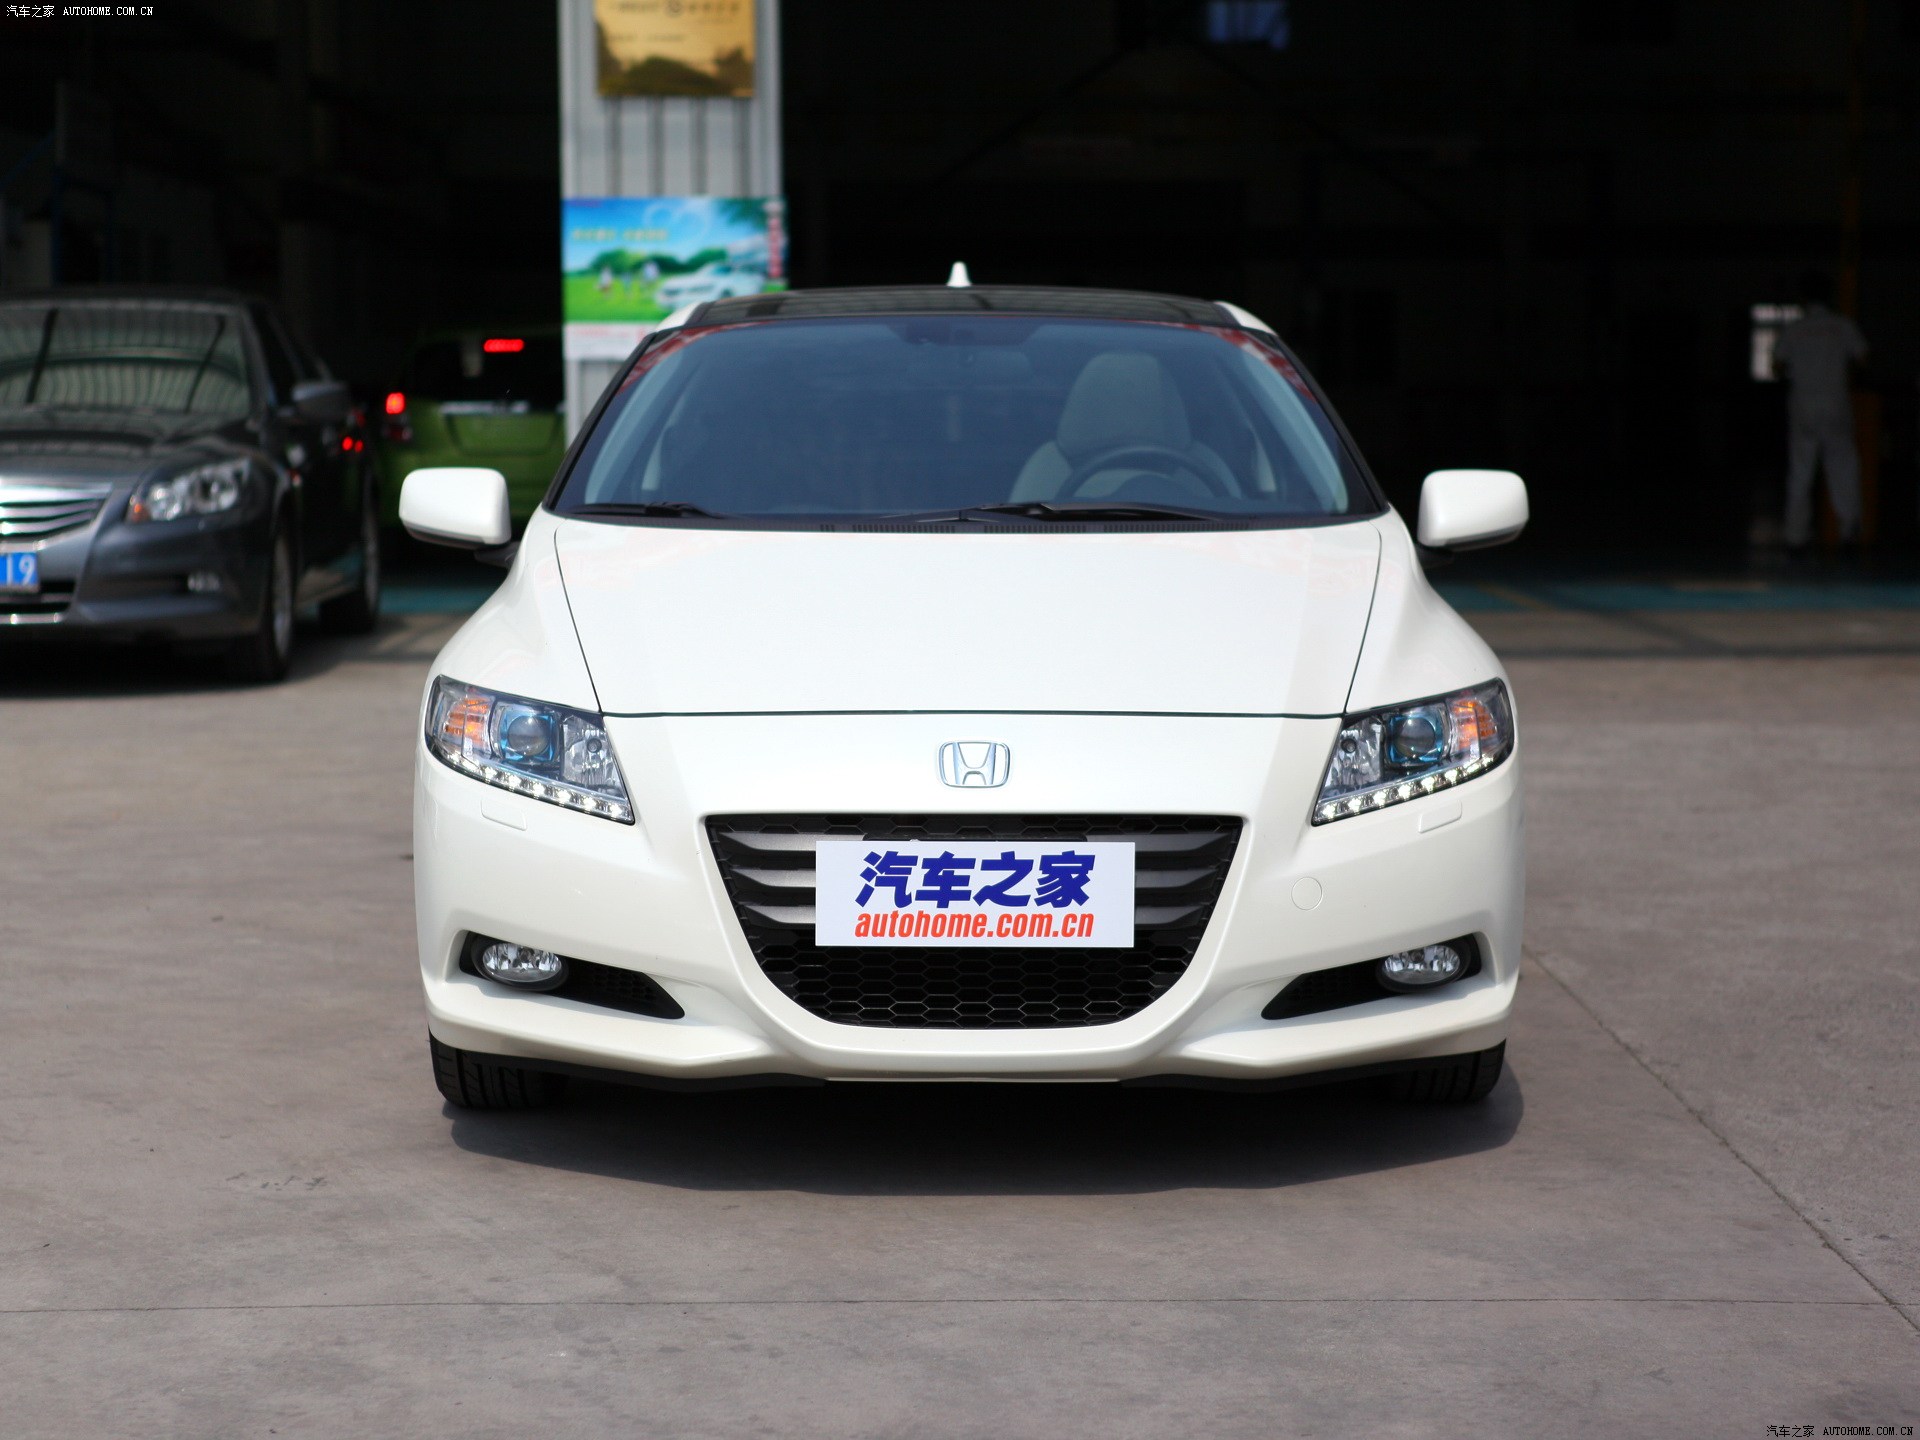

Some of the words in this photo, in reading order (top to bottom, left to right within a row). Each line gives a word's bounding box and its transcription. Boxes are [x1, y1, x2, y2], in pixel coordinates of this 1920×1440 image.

[855, 850, 1096, 909] 汽车之家
[854, 910, 1095, 938] autohome.com.cn
